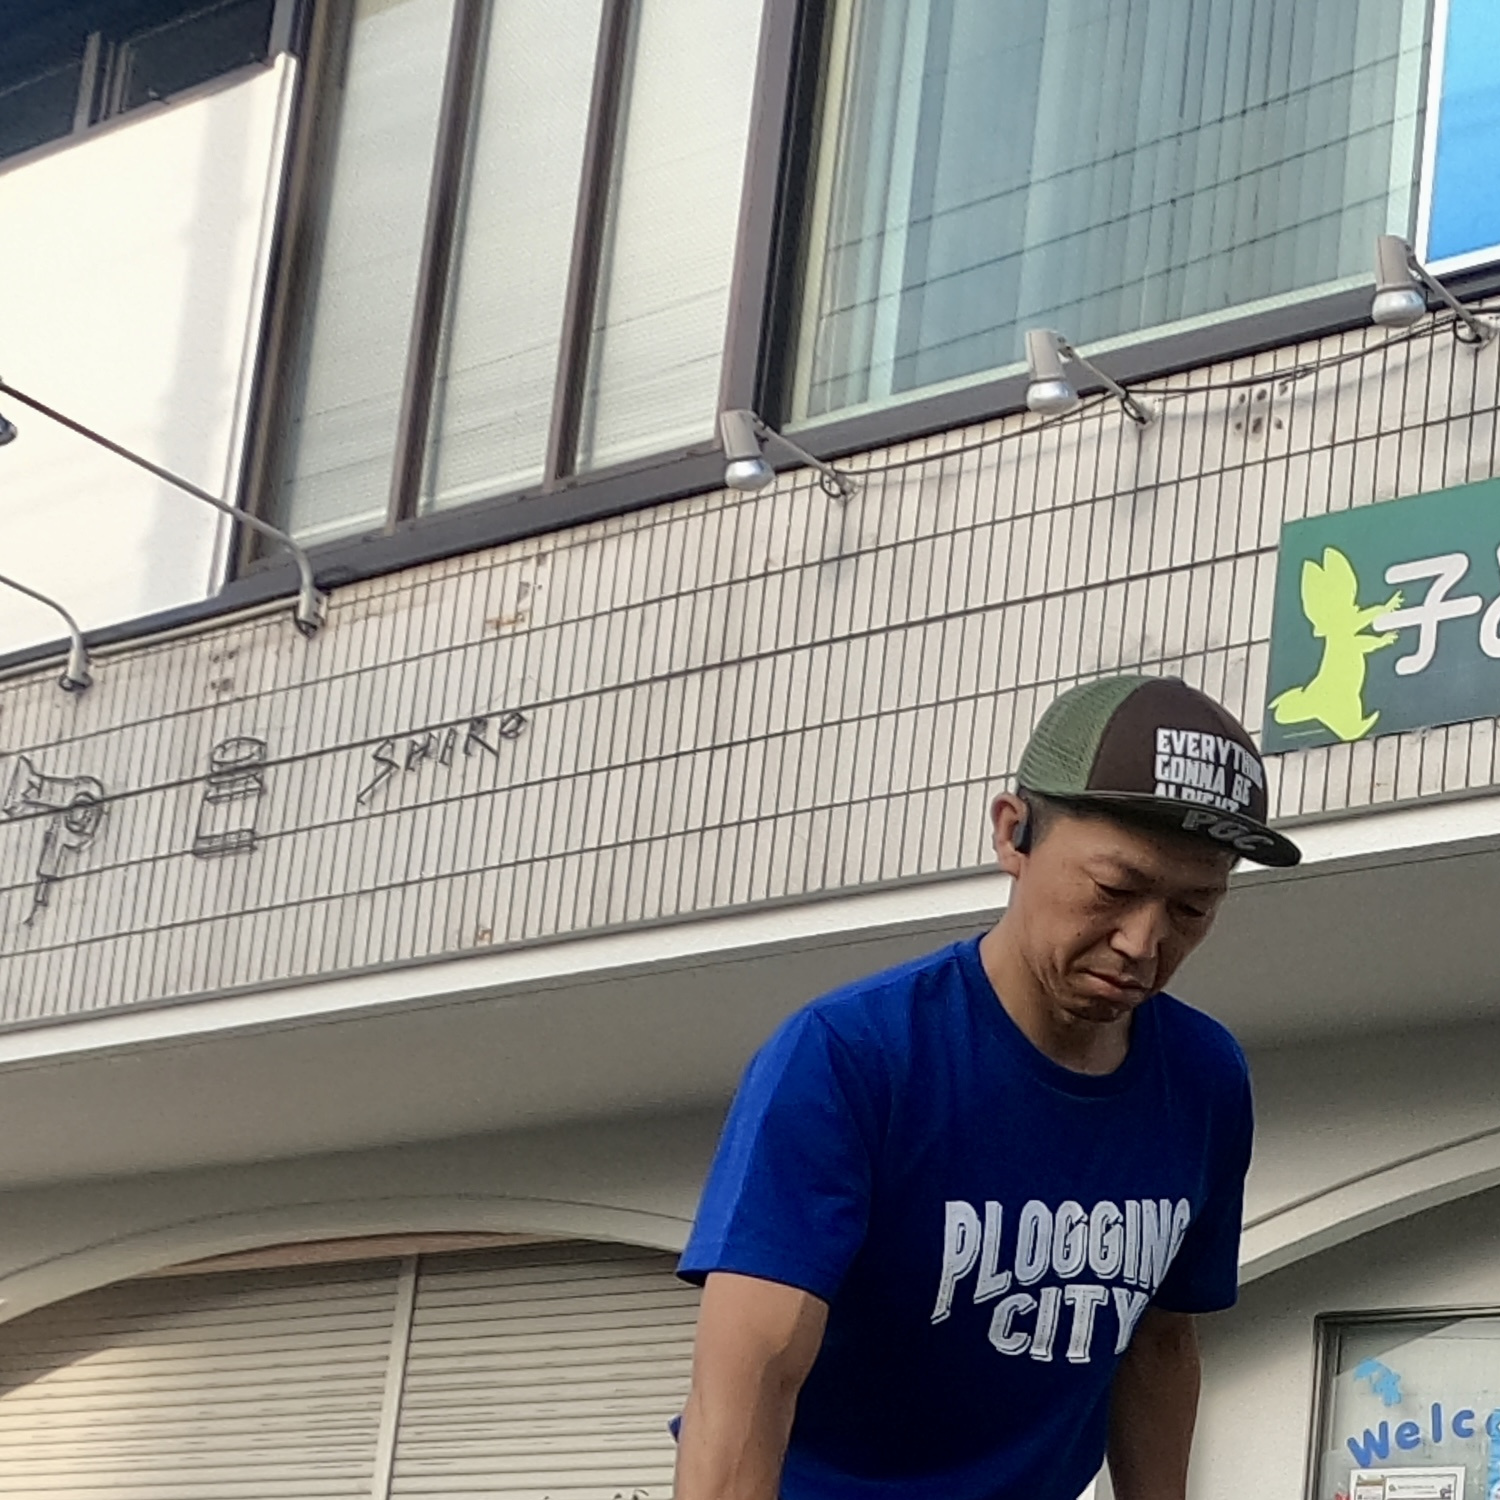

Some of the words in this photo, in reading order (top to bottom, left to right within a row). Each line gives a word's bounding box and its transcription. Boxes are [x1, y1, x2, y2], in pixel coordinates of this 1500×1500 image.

[1154, 753, 1226, 797] GONNA
[1231, 772, 1252, 807] BE
[988, 1284, 1150, 1363] CITY
[1346, 1401, 1495, 1470] Welc
